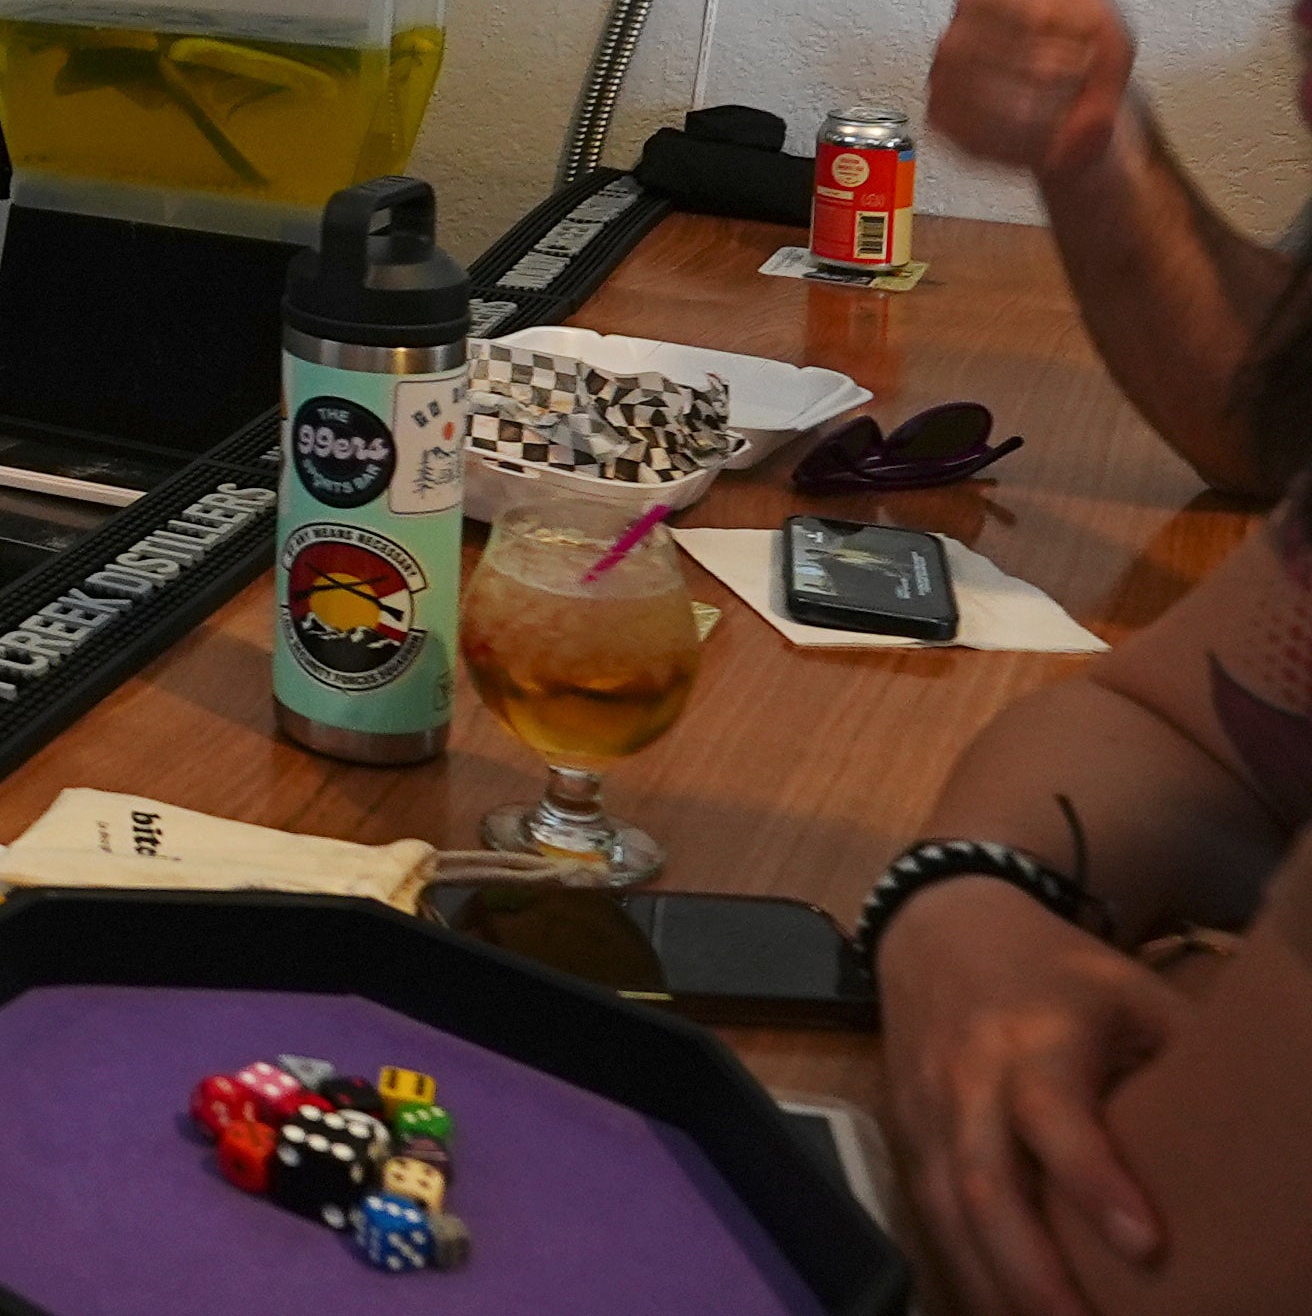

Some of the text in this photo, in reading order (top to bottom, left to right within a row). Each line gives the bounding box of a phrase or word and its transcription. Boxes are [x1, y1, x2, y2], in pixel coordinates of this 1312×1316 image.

[316, 407, 350, 424] THE
[297, 424, 390, 460] 99ers
[84, 481, 277, 604] DISTILLERS
